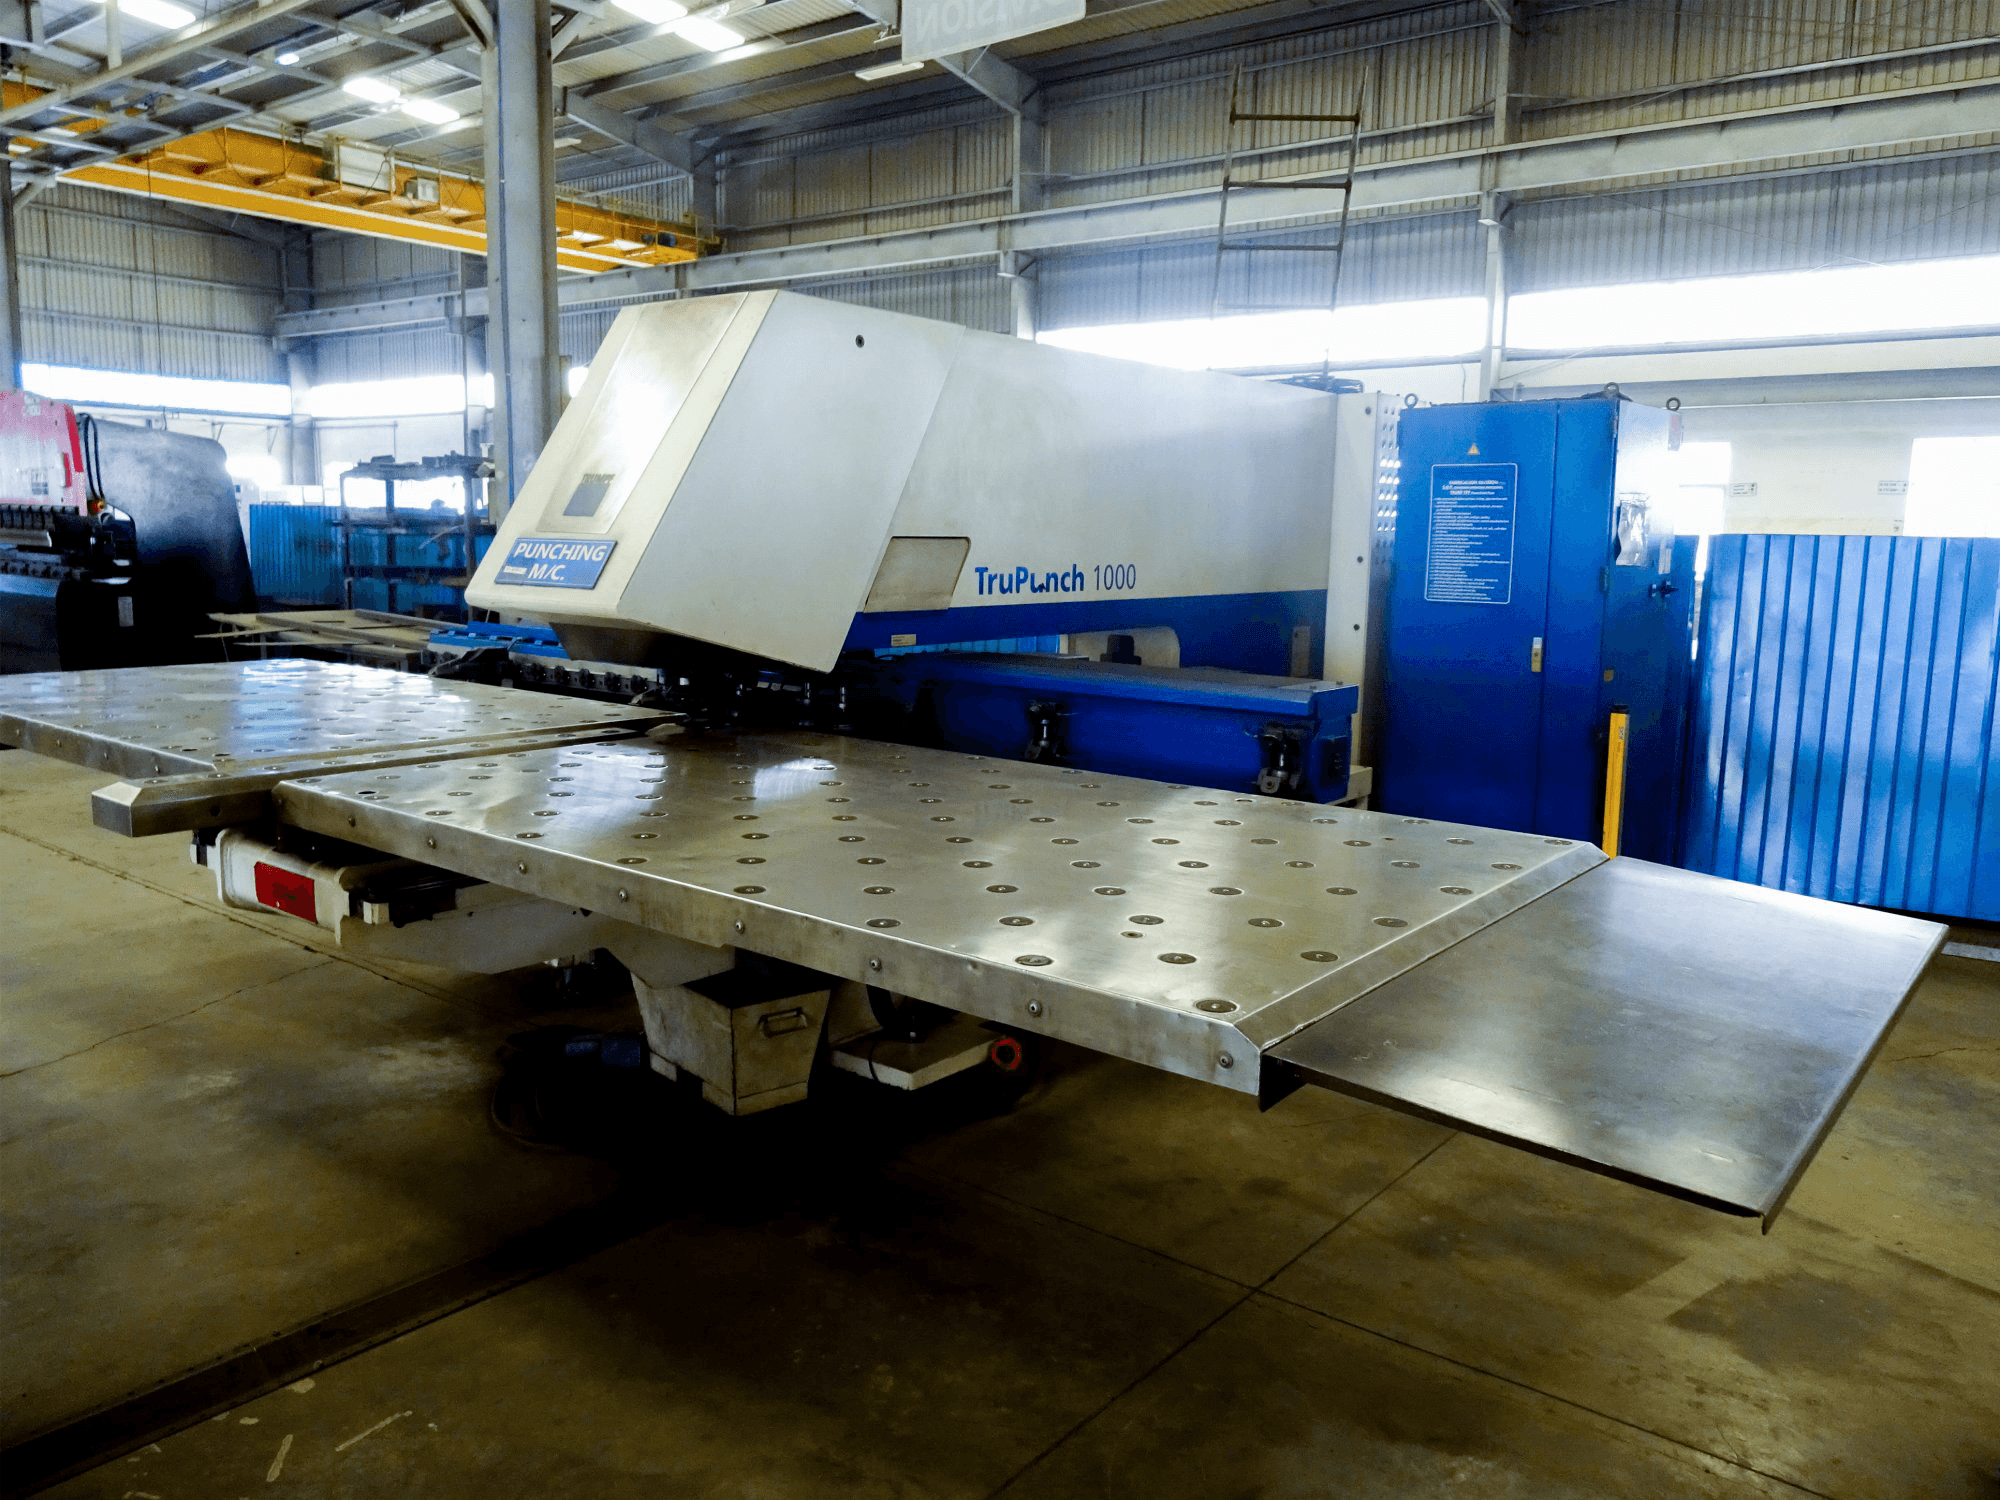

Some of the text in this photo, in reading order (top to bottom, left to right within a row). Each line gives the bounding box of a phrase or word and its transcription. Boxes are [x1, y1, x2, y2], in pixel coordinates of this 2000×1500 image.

[513, 542, 608, 562] PUNCHING
[528, 563, 566, 581] M/C.
[975, 563, 1137, 596] TruPunch 1000
